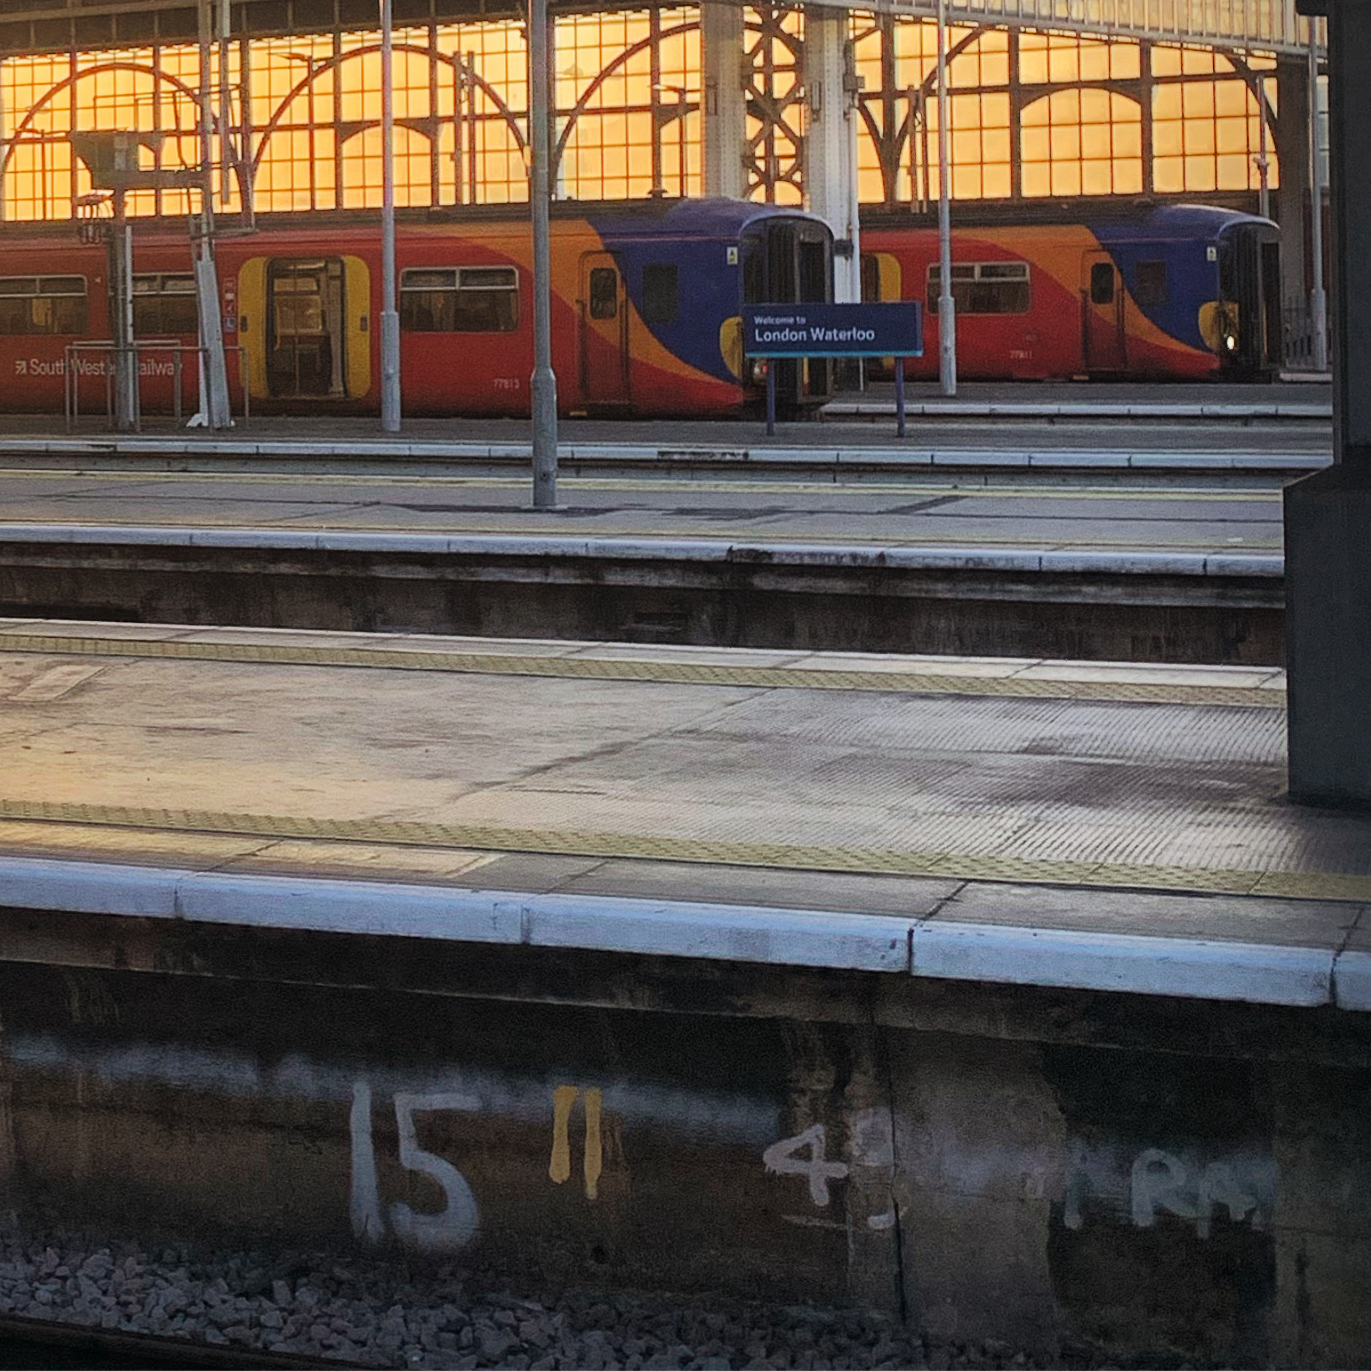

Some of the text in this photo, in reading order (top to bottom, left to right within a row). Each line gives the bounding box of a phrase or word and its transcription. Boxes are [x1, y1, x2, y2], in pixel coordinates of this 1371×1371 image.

[754, 316, 806, 325] Welcome to
[755, 327, 875, 342] London Waterloo
[70, 358, 118, 375] West
[137, 358, 183, 376] ailwa
[350, 1081, 481, 1245] 15
